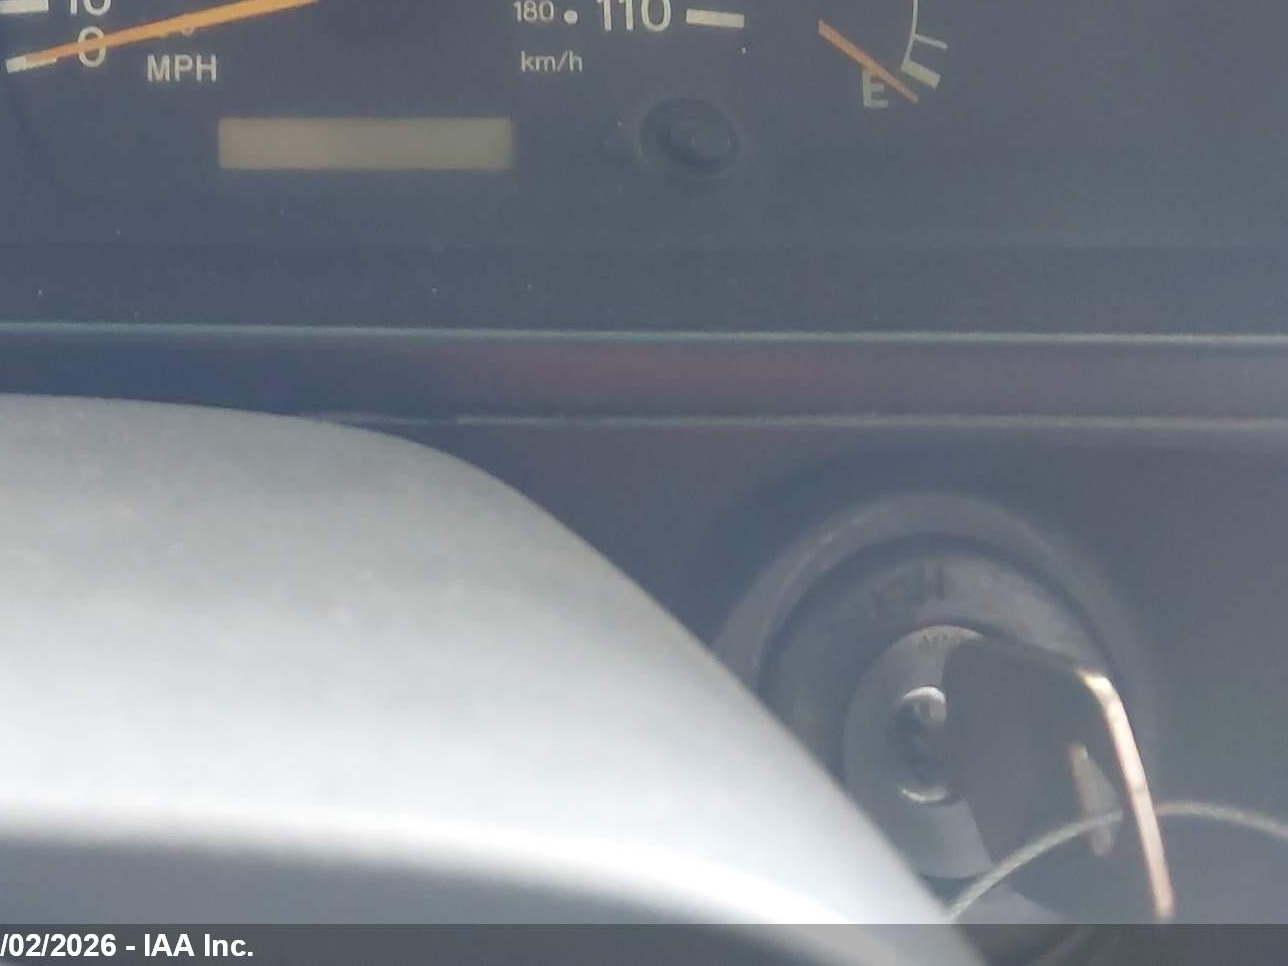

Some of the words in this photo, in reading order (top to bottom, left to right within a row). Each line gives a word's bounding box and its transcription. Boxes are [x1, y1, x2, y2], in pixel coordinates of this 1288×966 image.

[514, 0, 554, 21] 180
[77, 26, 107, 67] 0
[148, 55, 216, 82] MPH
[521, 50, 582, 72] km/h
[861, 70, 889, 109] E
